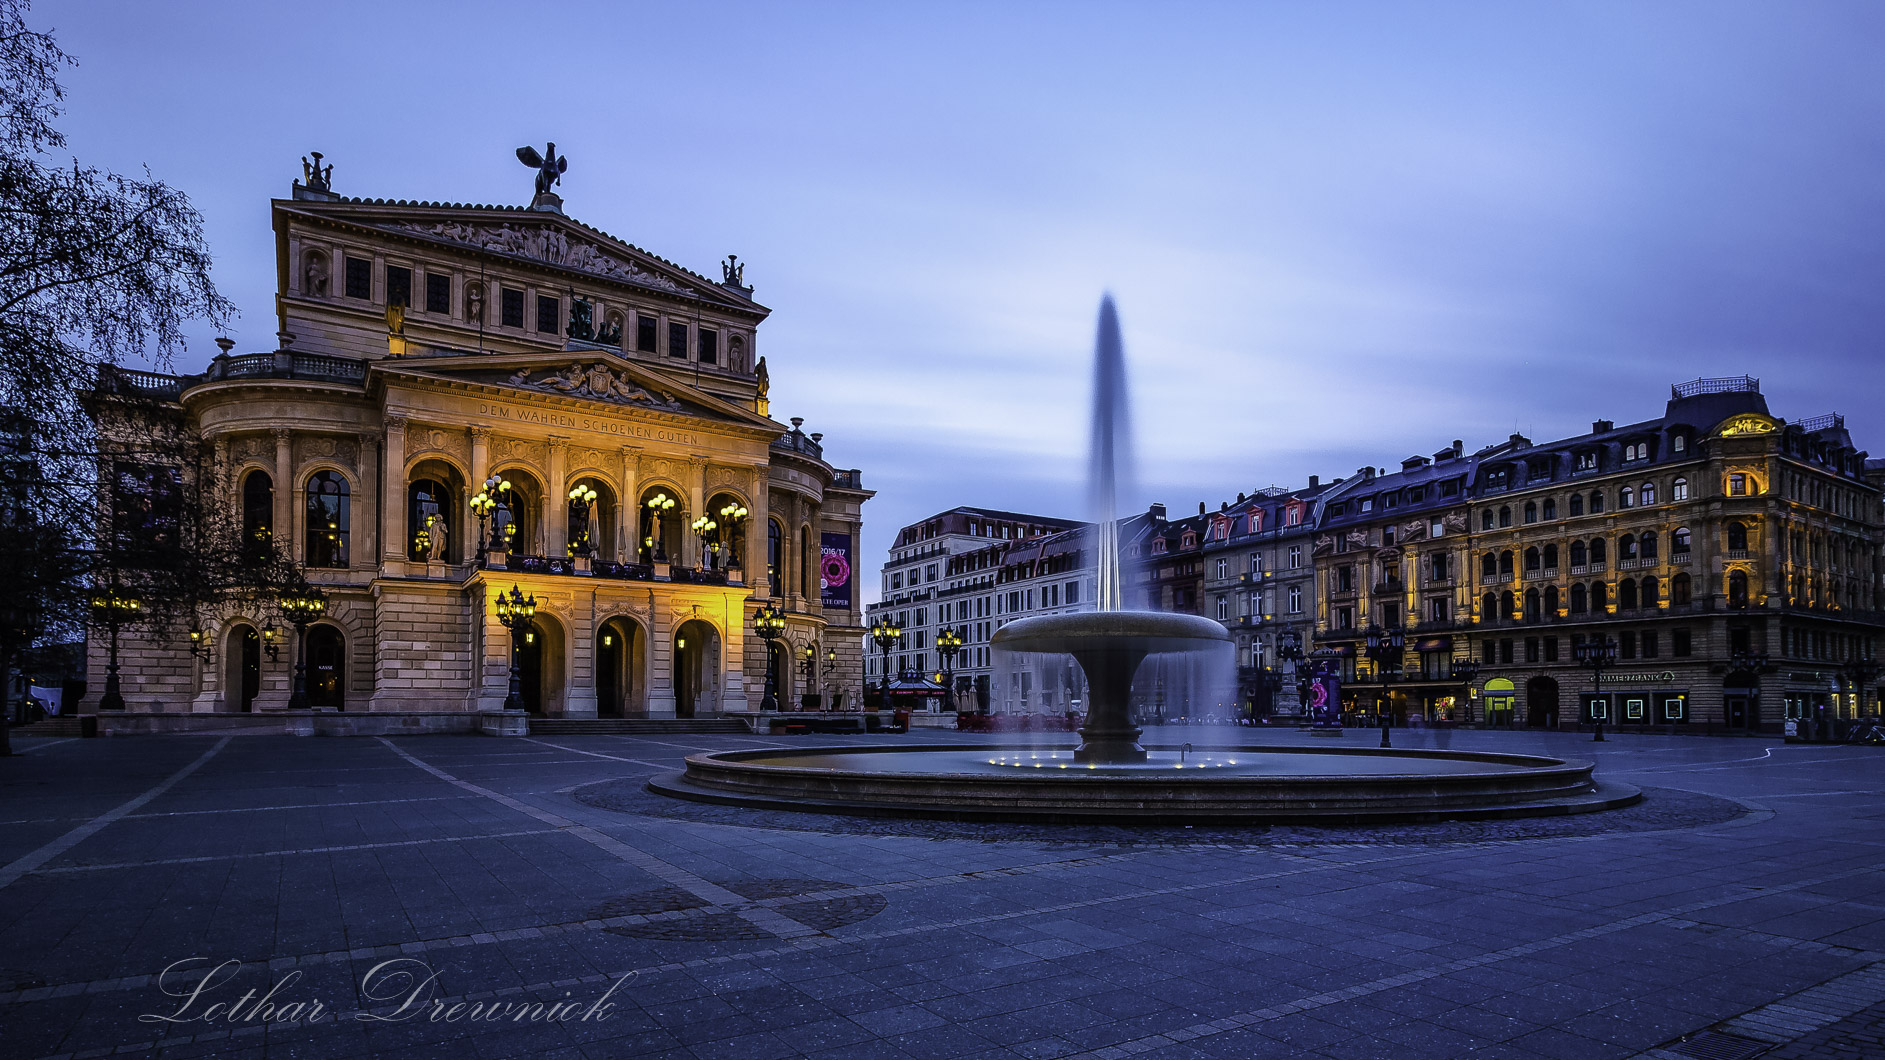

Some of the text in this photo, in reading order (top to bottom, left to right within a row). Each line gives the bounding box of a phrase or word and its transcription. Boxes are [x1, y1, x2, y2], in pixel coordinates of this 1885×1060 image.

[479, 404, 510, 417] DEM
[517, 409, 576, 427] WAHREN
[583, 420, 652, 439] SCHOENEN
[820, 547, 846, 556] 2016/17
